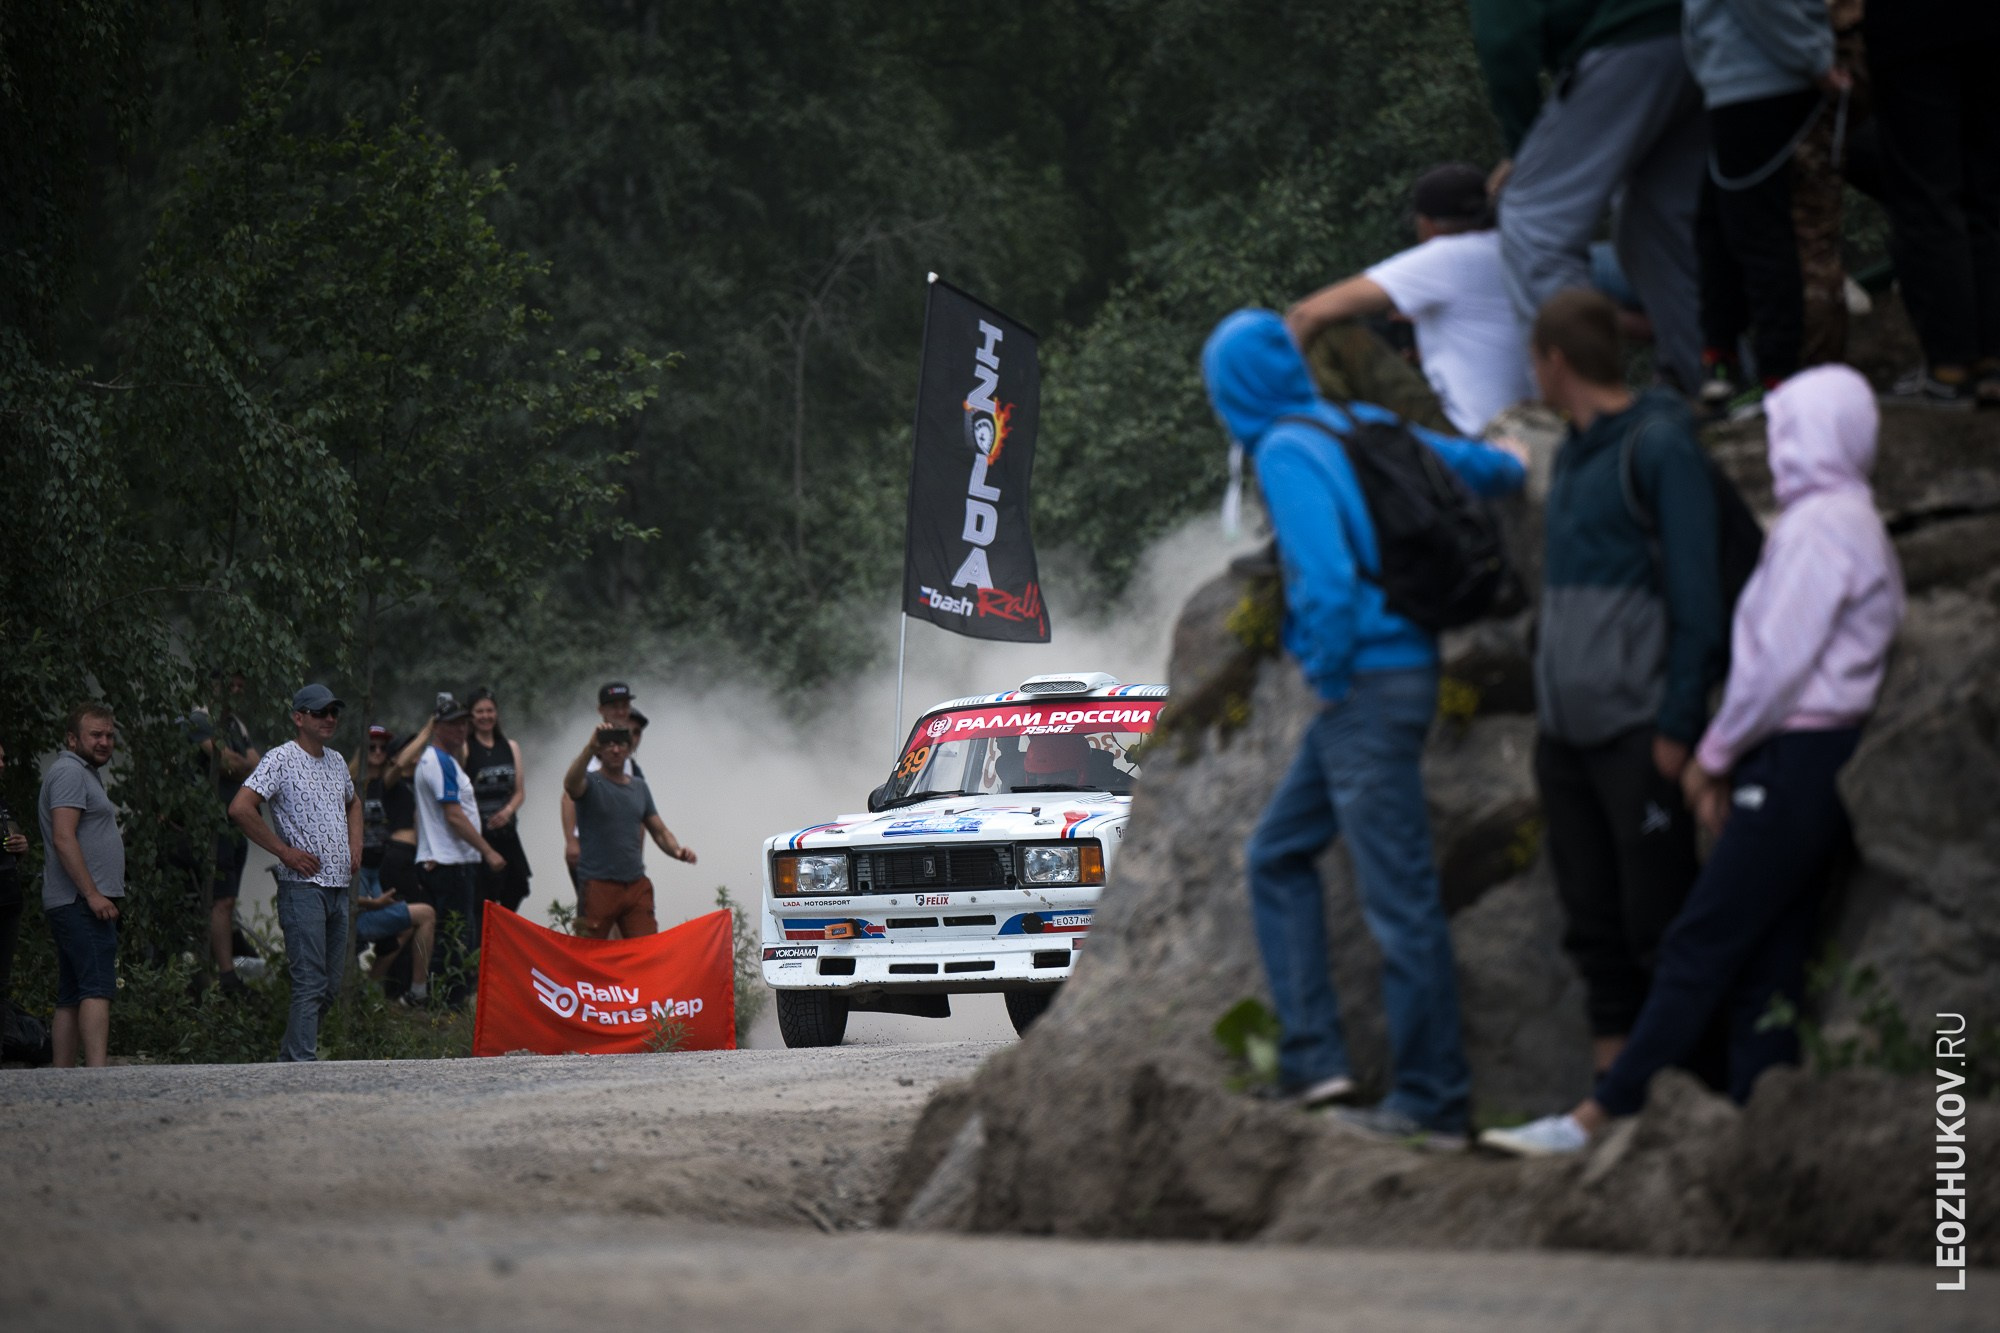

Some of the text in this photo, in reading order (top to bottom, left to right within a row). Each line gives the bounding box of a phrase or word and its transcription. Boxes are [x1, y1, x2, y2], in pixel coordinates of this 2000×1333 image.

[954, 709, 1151, 732] РАЛЛИ РОССИИ
[897, 746, 930, 778] 39
[804, 899, 851, 907] MOTORSPORT
[926, 896, 949, 906] FELIX
[774, 948, 818, 958] YOKOHAMA
[576, 981, 639, 1005] Rally
[581, 998, 703, 1025] Fans Map
